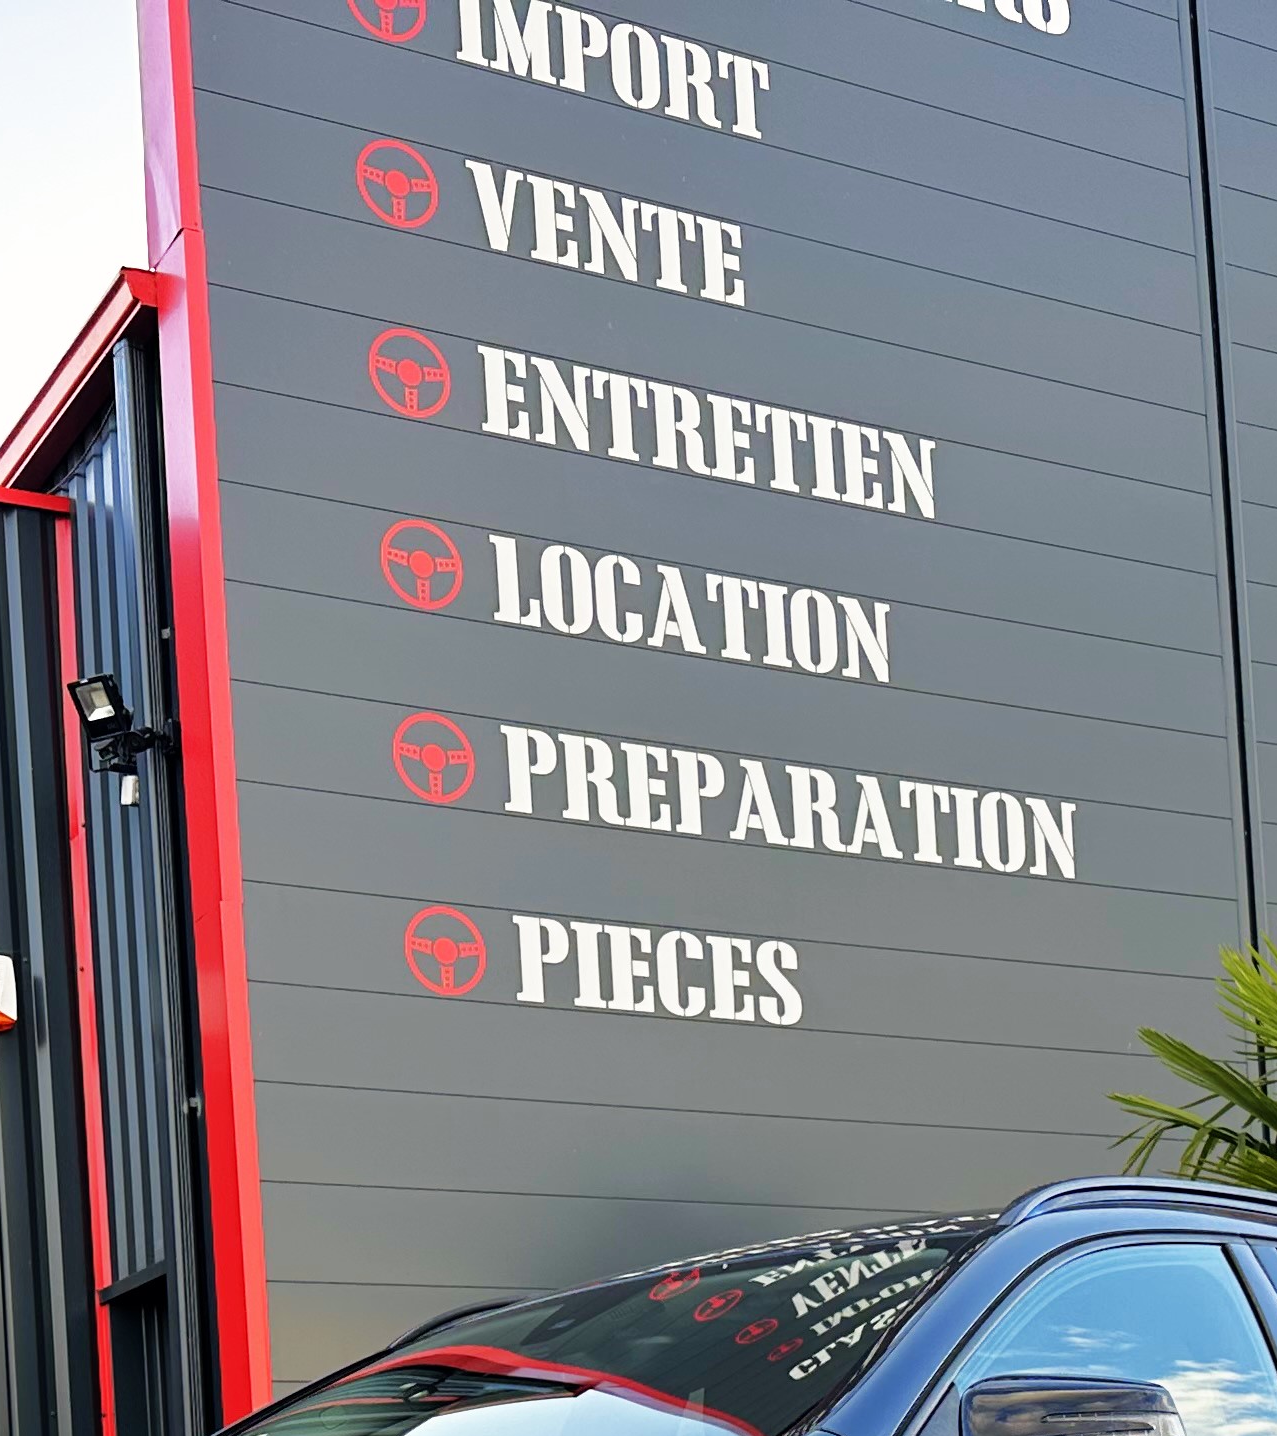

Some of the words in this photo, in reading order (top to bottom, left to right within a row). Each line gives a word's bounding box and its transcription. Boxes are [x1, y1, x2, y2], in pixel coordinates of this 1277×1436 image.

[457, 0, 770, 140] IMPORT
[464, 159, 745, 307] VENTE
[477, 344, 936, 519] ENTRETIEN
[488, 533, 891, 683] LOCATION
[499, 724, 1078, 880] PREPARATION
[512, 914, 803, 1026] PIECES
